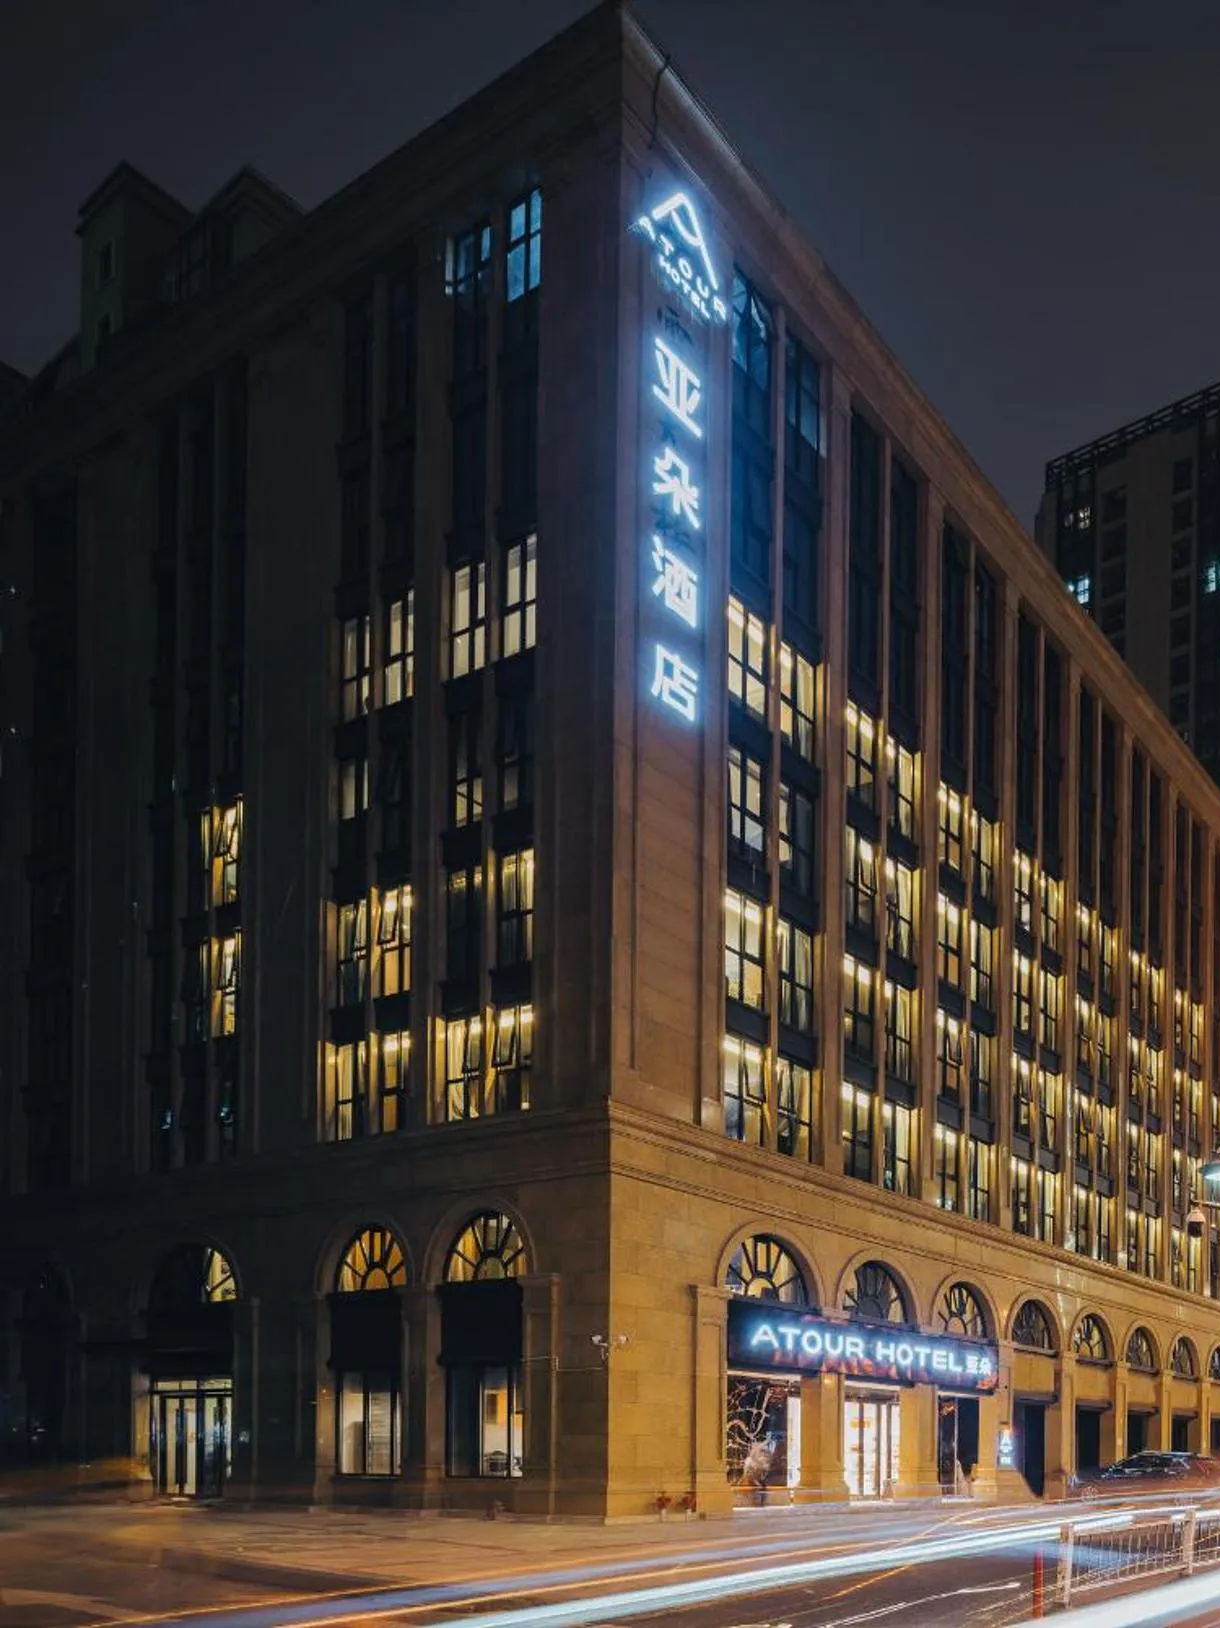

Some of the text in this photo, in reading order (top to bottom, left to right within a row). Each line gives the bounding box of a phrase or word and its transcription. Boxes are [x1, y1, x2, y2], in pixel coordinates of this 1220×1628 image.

[658, 253, 711, 320] HOTEL
[651, 336, 702, 722] 亚朵酒店
[751, 1324, 966, 1373] ATOUR HOTEL
